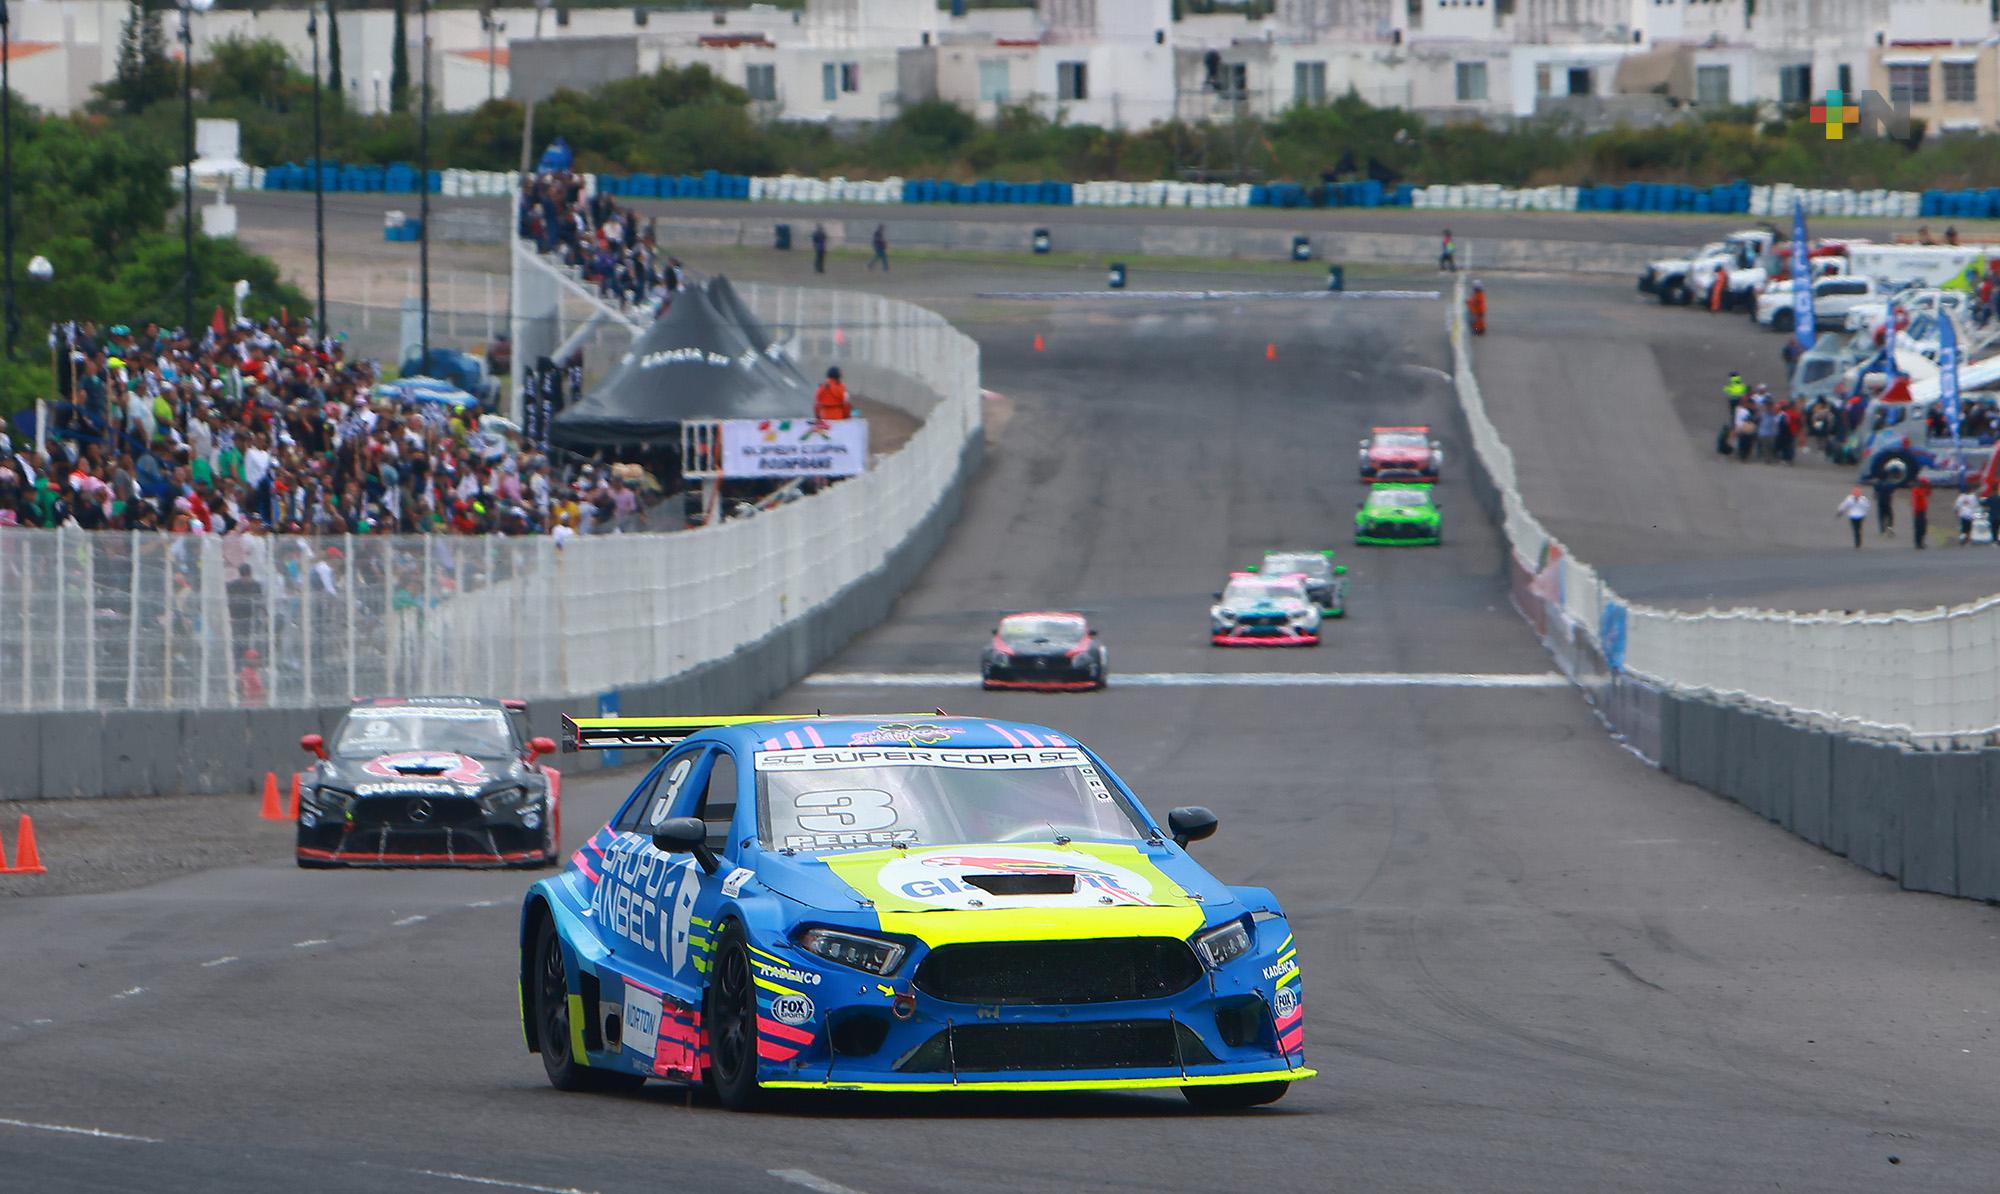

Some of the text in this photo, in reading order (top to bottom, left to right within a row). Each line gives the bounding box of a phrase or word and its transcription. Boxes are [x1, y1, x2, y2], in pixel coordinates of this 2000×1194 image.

[940, 753, 1032, 764] COPA
[651, 759, 692, 827] 3
[794, 788, 898, 833] 3
[784, 829, 920, 848] PEREZ
[601, 831, 672, 899] GRUPO
[583, 873, 656, 952] ANBEC
[781, 1000, 805, 1013] FOX
[1279, 992, 1294, 1007] FOX
